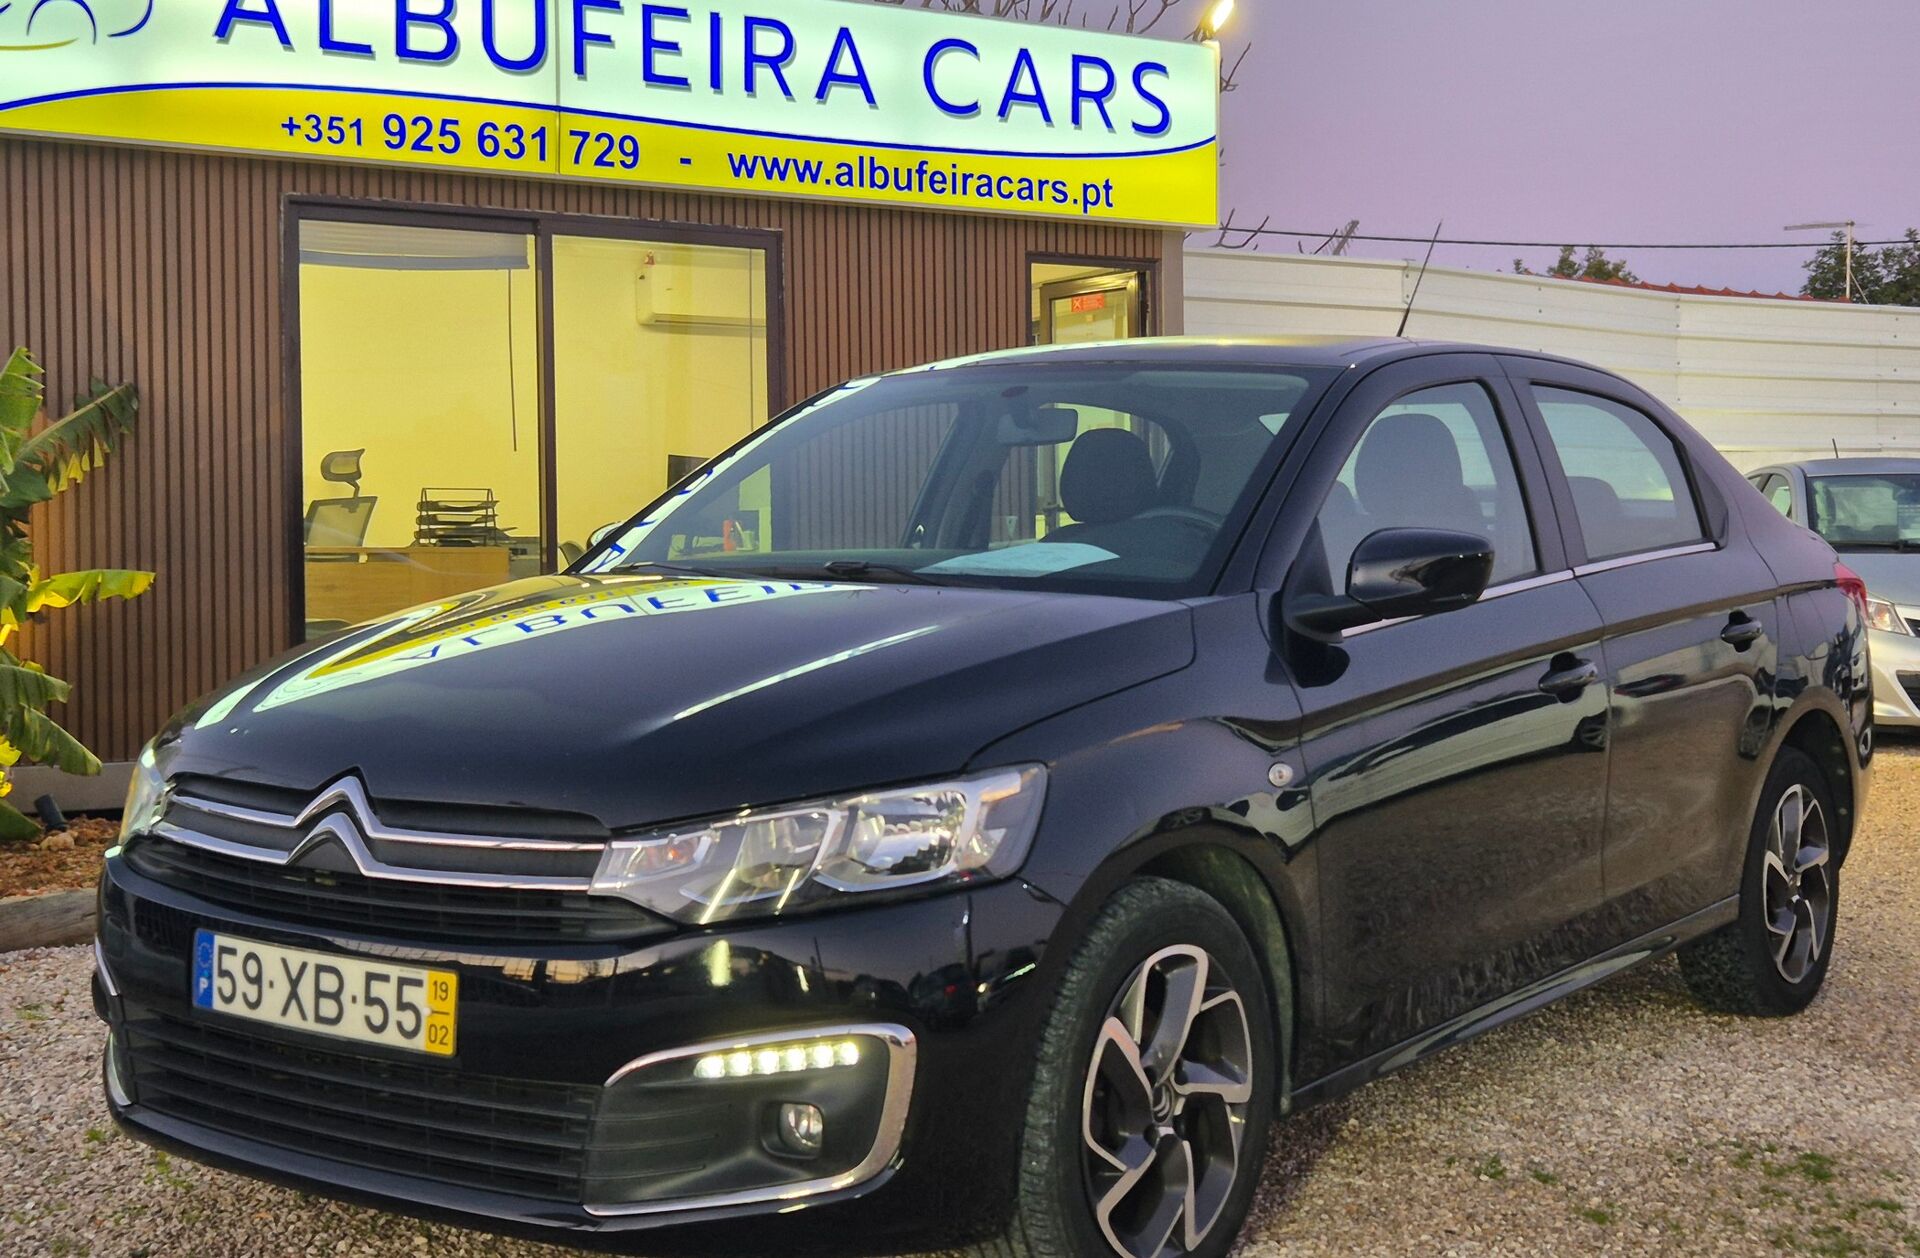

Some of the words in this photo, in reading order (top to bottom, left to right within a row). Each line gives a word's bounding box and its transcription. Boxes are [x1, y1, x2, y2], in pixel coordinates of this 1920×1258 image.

[215, 0, 879, 107] ALBUFEIRA
[923, 38, 1172, 136] CARS
[281, 113, 363, 146] +351
[383, 113, 461, 155] 925
[477, 122, 547, 162] 631
[569, 129, 640, 170] 729
[728, 153, 1114, 214] www.albufeiracars.pt
[431, 979, 449, 1002] 19
[427, 1023, 450, 1046] 02
